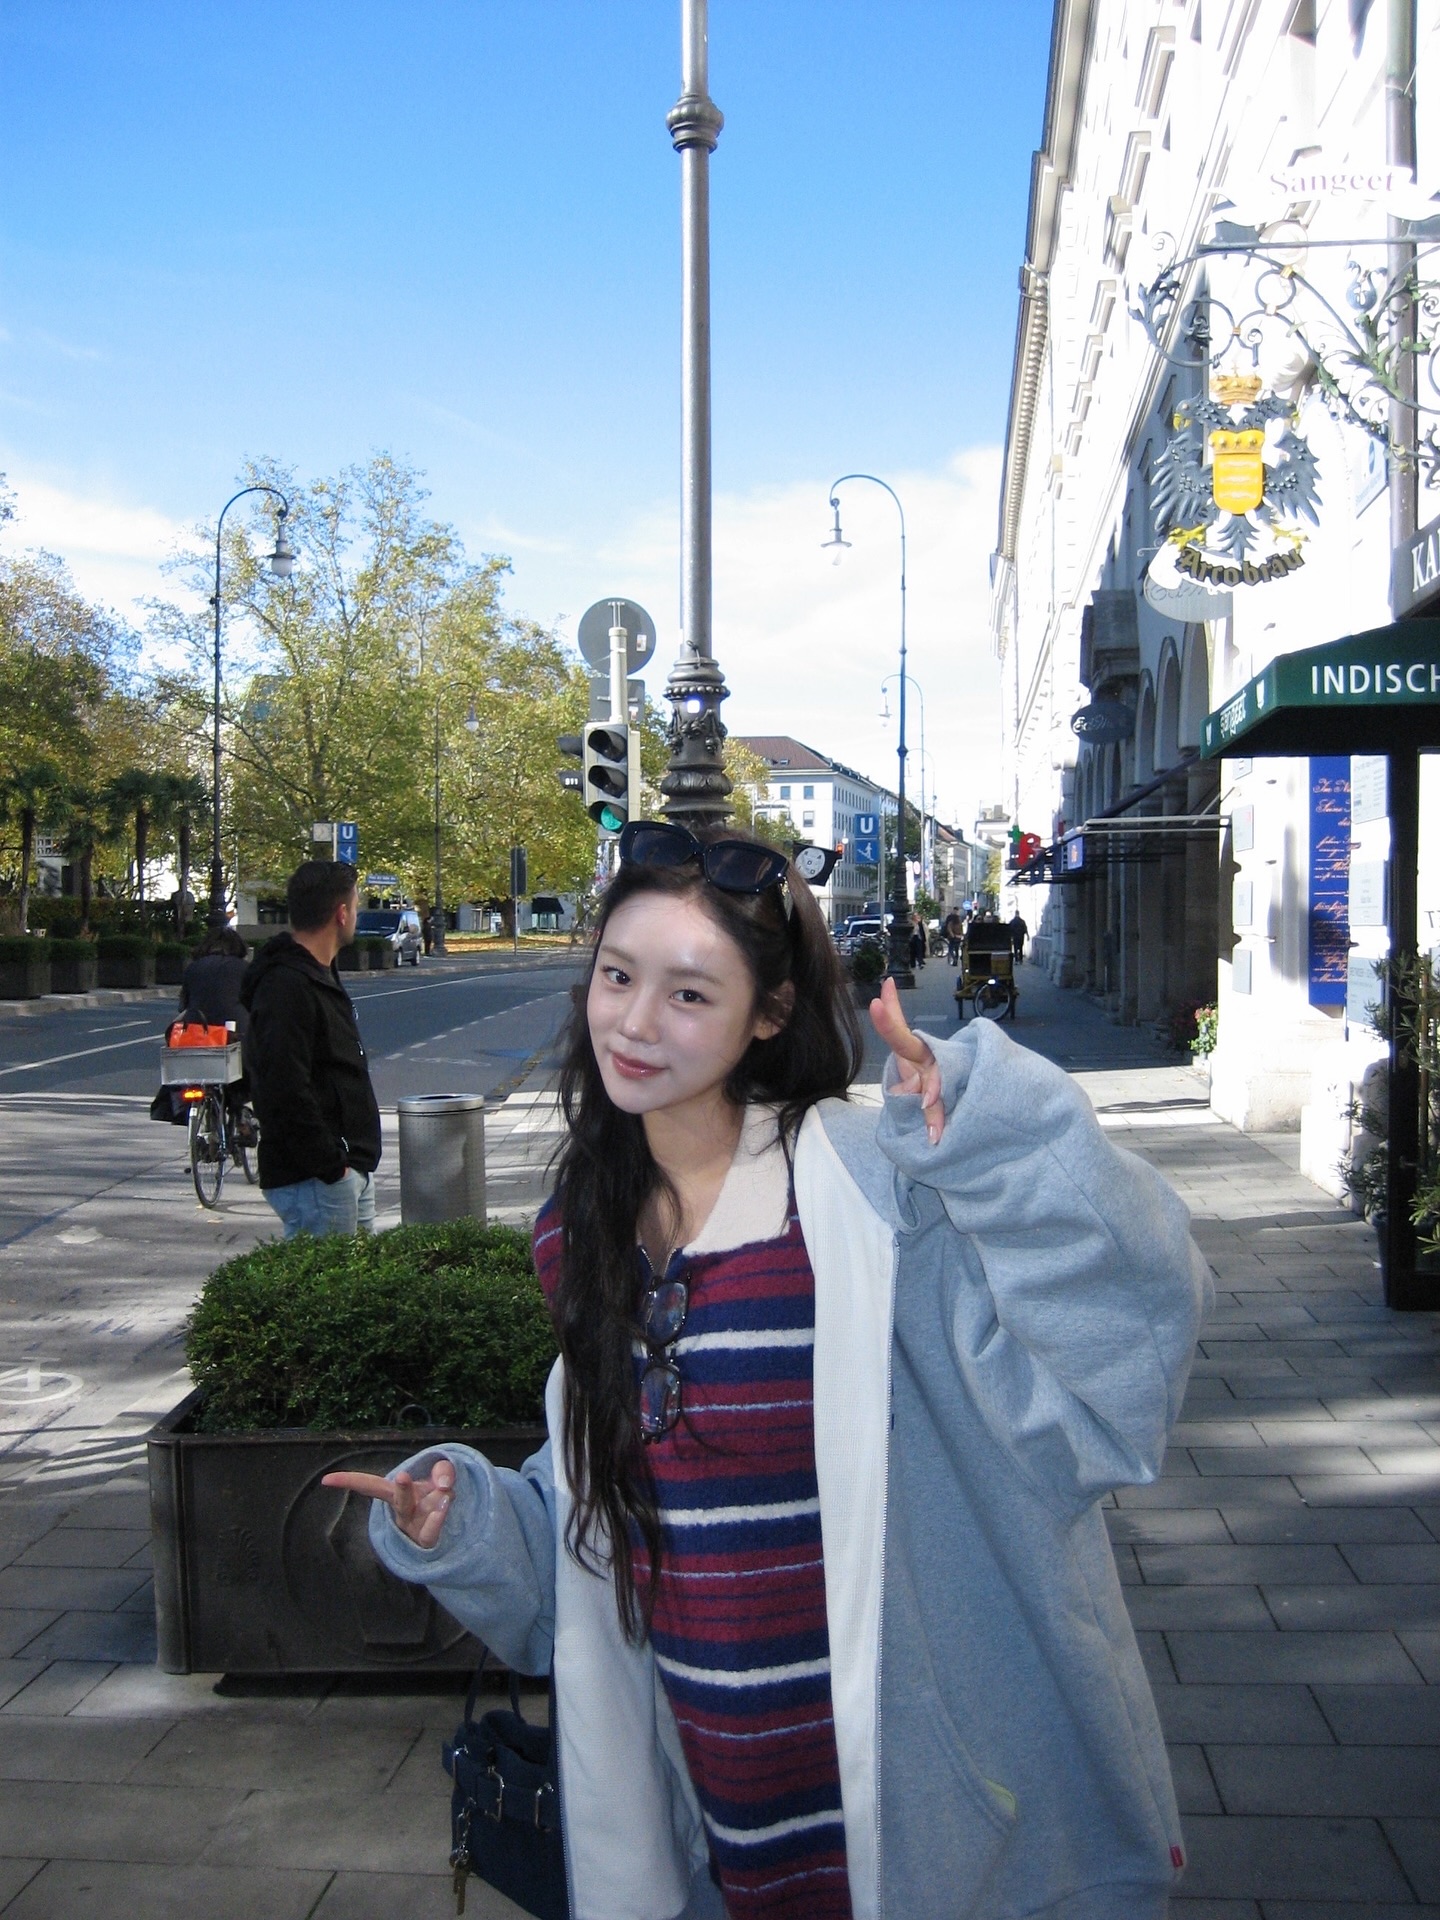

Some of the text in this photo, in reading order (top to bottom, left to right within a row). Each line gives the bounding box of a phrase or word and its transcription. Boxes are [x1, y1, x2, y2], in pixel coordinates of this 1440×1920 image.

[1270, 172, 1393, 196] Sangeet
[342, 825, 353, 839] U
[860, 817, 873, 834] U
